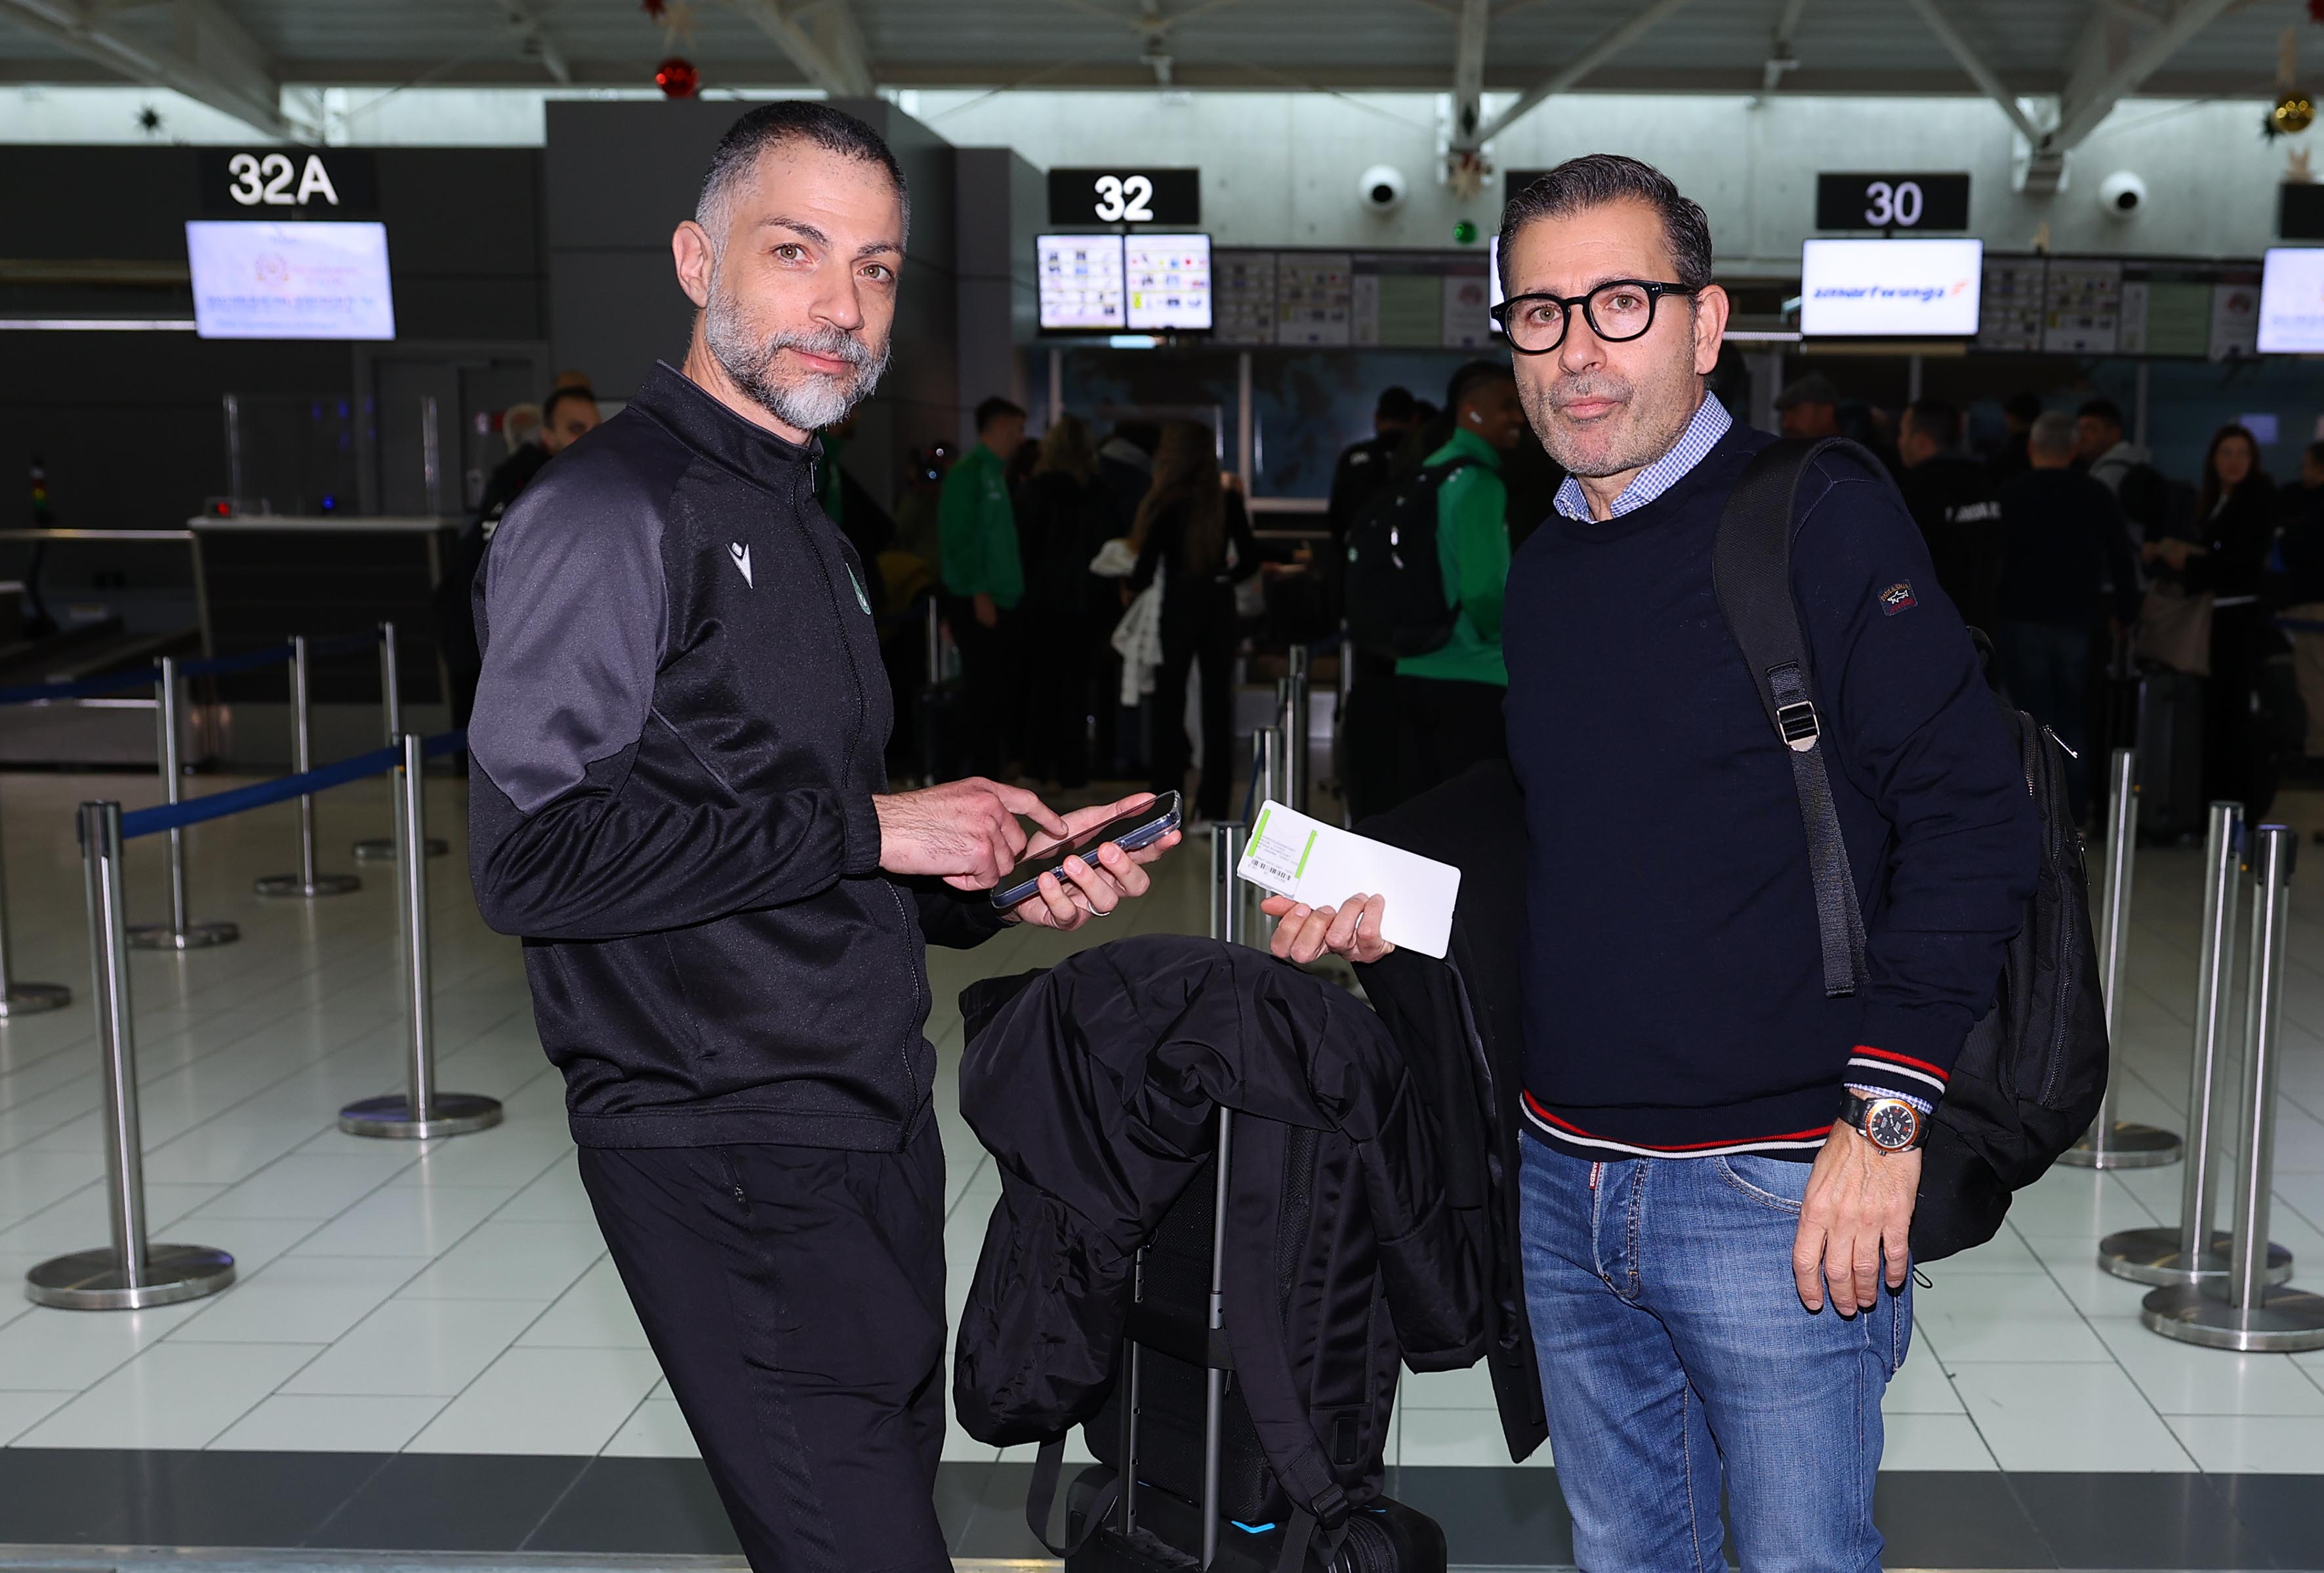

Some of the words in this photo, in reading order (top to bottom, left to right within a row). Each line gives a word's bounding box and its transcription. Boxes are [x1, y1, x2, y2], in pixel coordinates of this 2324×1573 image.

[228, 153, 339, 205] 32A
[1094, 174, 1154, 222] 32
[1864, 181, 1923, 226] 30
